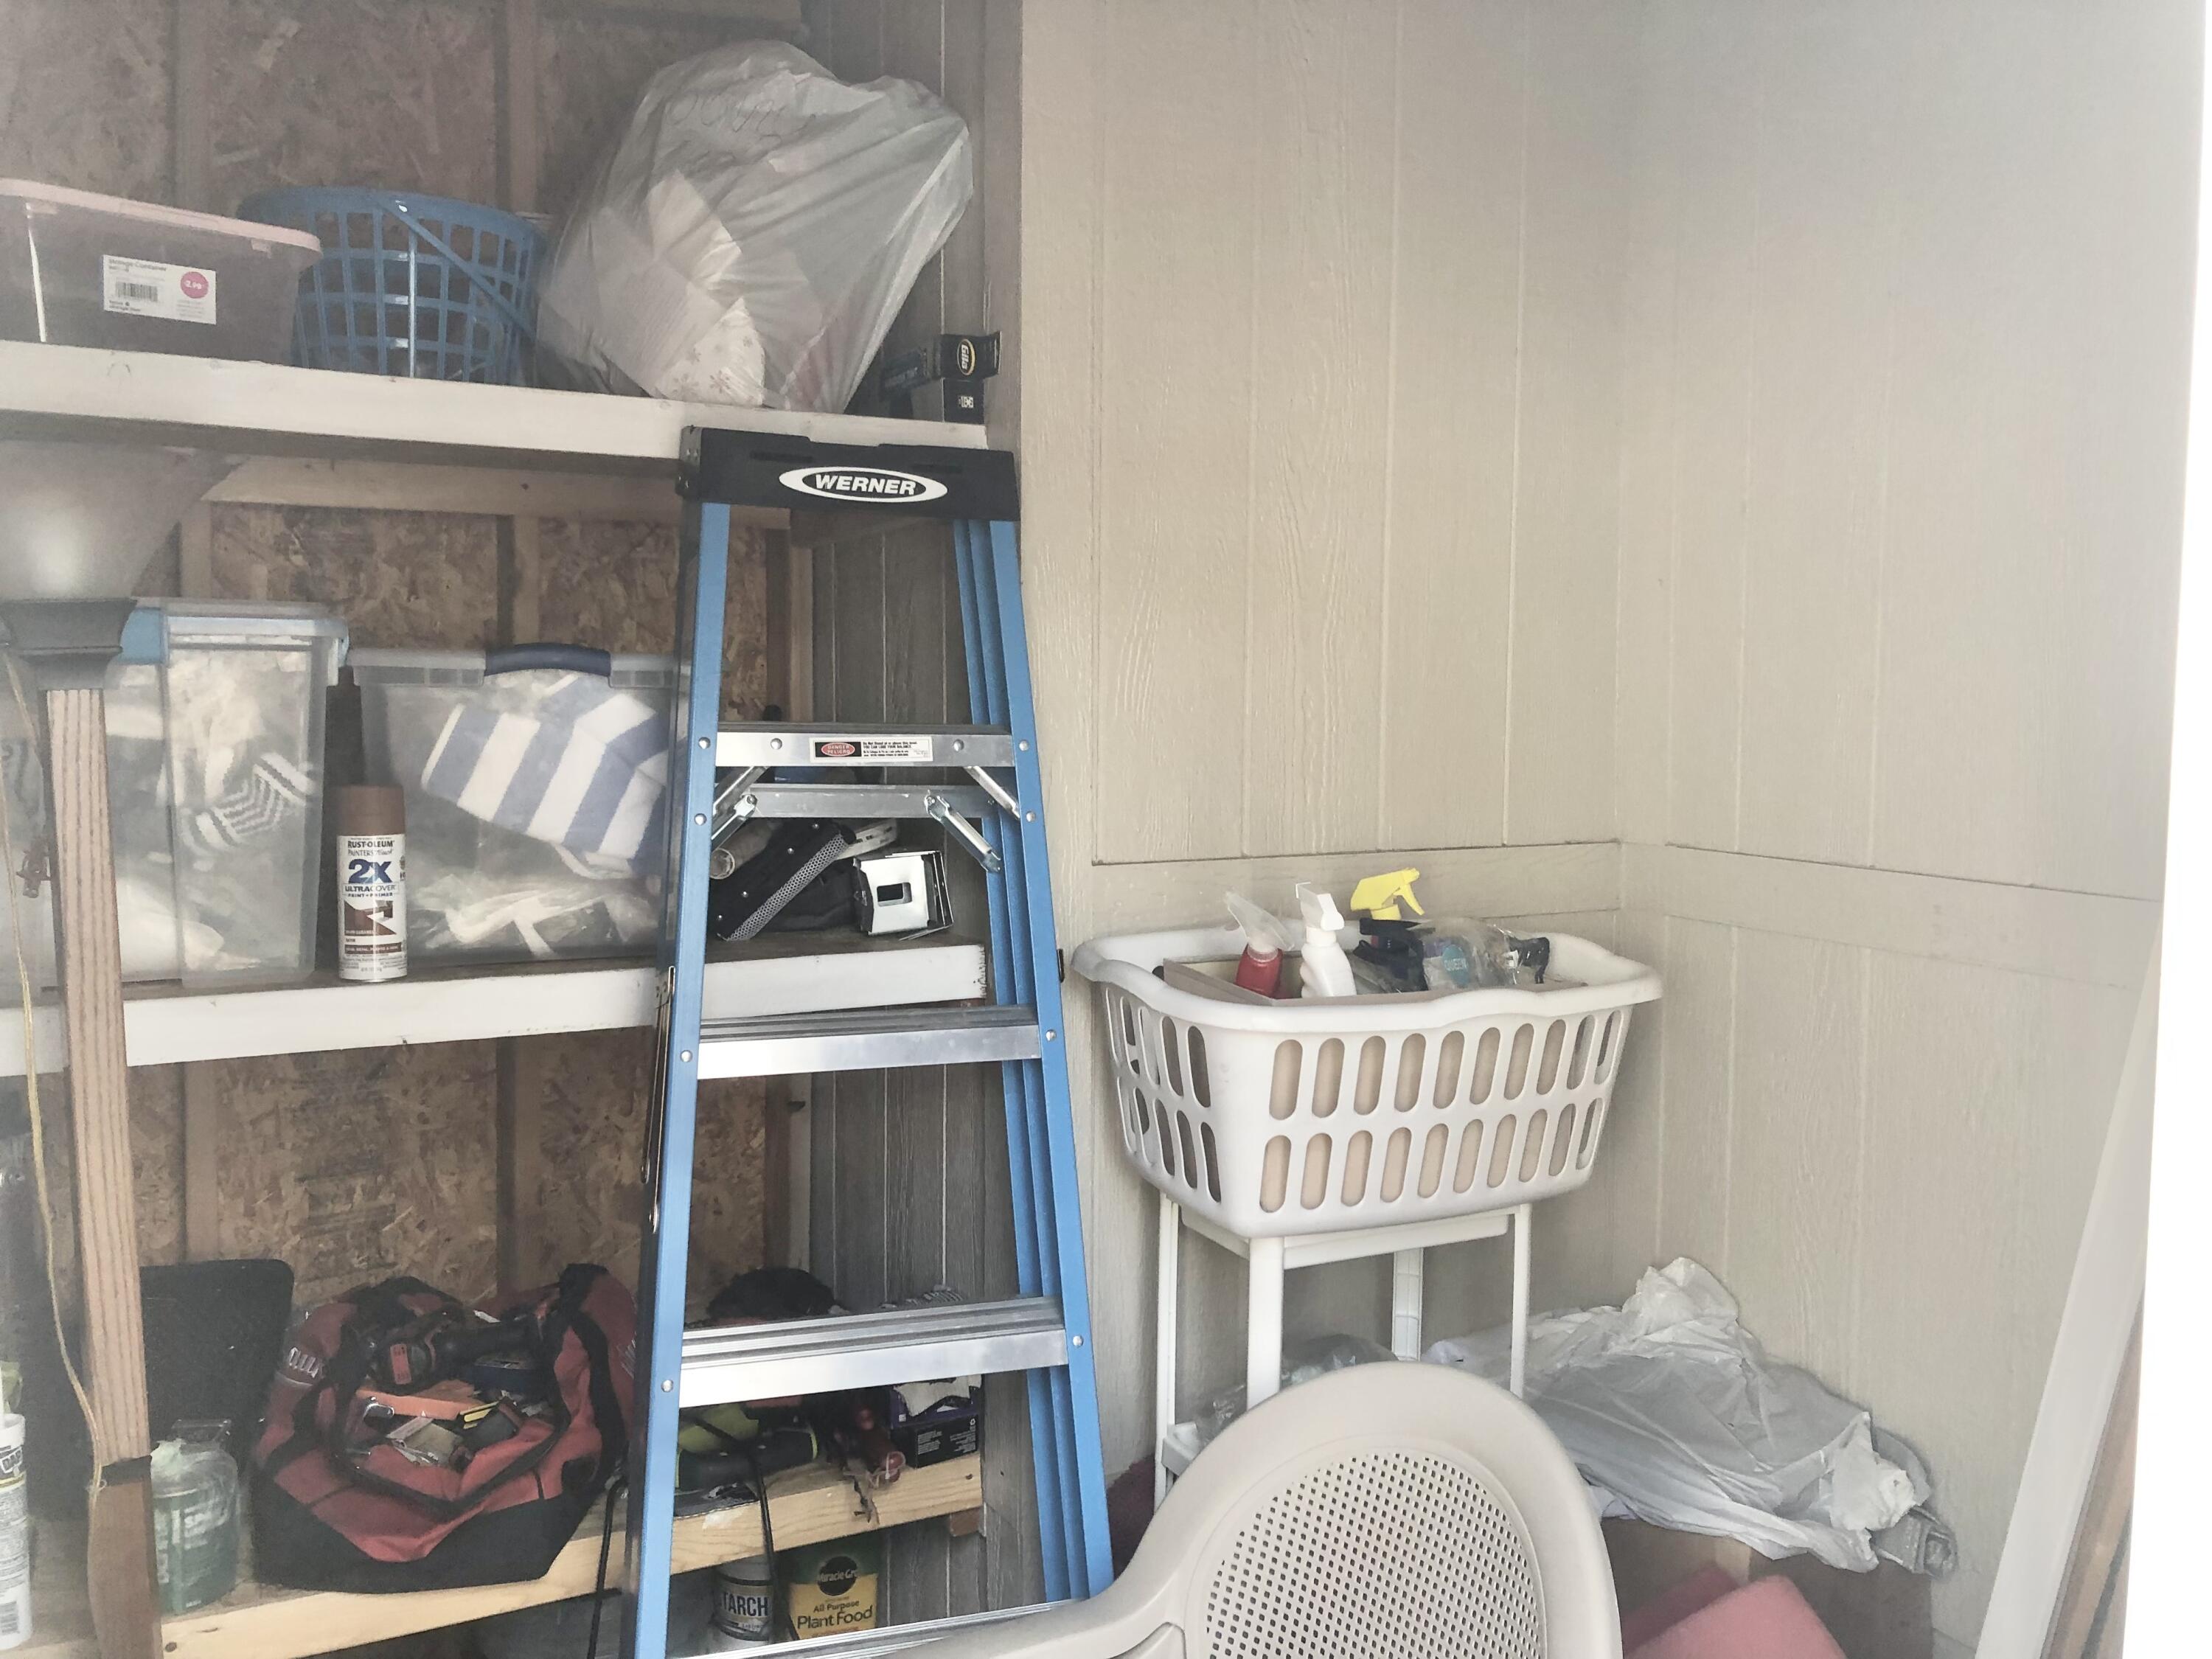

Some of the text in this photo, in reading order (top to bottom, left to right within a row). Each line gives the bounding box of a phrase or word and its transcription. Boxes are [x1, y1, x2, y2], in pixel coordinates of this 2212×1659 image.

[815, 474, 916, 495] WERNER
[348, 858, 392, 883] 2X
[718, 1592, 768, 1617] TARCH
[797, 1604, 873, 1630] Plant Food
[813, 1601, 860, 1613] All Purpose
